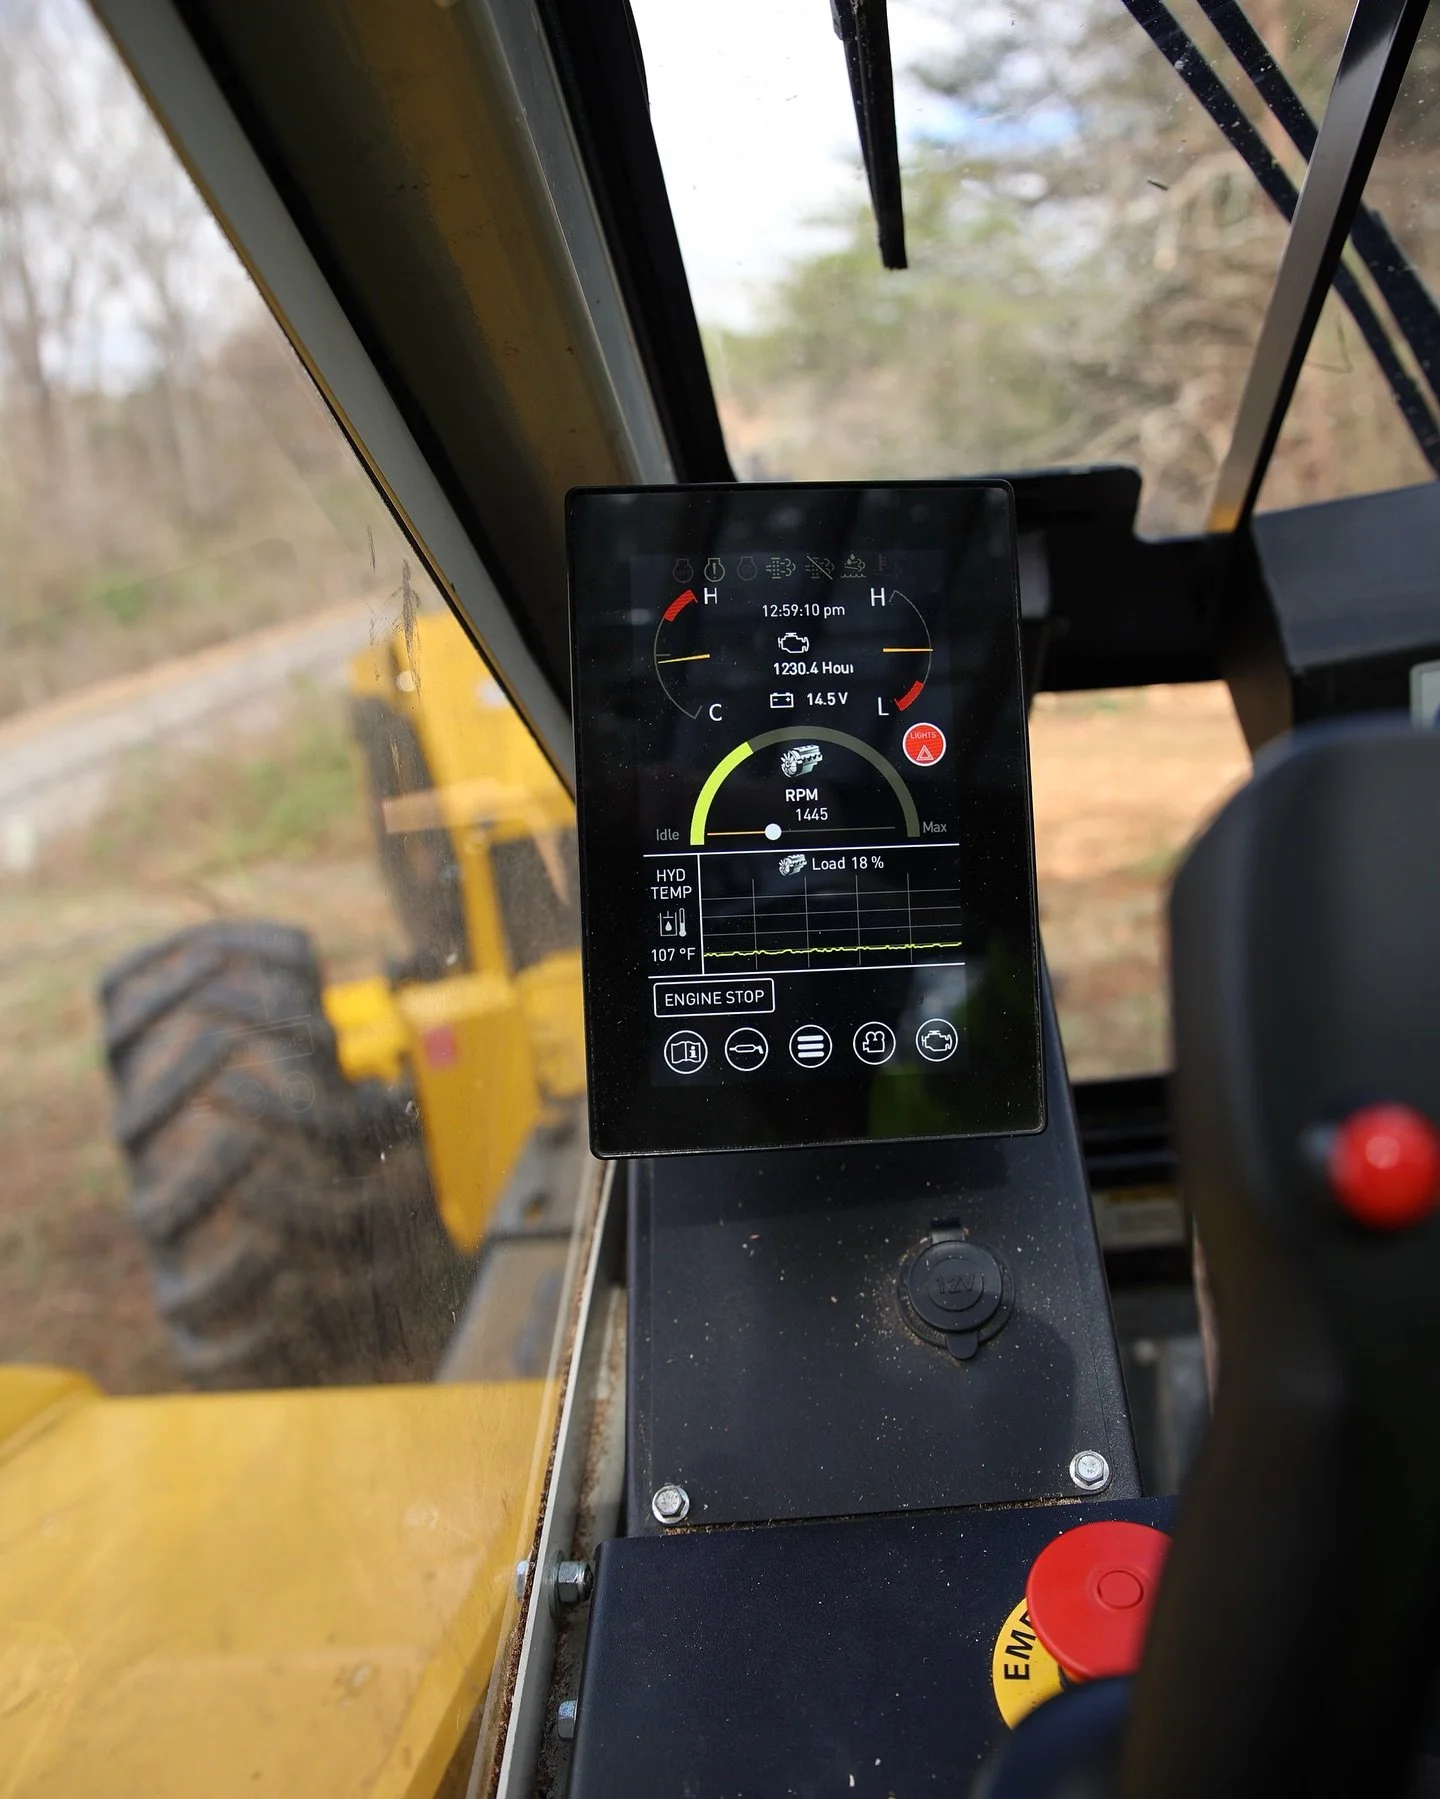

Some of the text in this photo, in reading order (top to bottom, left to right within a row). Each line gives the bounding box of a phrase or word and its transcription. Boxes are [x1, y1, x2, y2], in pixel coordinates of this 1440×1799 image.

[704, 588, 717, 604] H
[871, 588, 885, 606] H
[763, 604, 845, 618] 12:59:10 pm
[774, 662, 818, 675] 1230.4
[807, 692, 848, 705] 14.5 V
[709, 704, 722, 721] C
[878, 697, 889, 715] L
[909, 731, 937, 740] LIGHTS
[786, 788, 818, 801] RPM
[796, 808, 828, 821] 1445
[923, 821, 946, 833] Max
[656, 829, 679, 840] Idle
[813, 856, 884, 870] Load 18 %
[657, 869, 685, 882] HYD
[651, 886, 692, 899] TEMP
[652, 948, 695, 961] 107 °F
[665, 990, 764, 1006] ENGINE STOP
[936, 1273, 975, 1294] 12V
